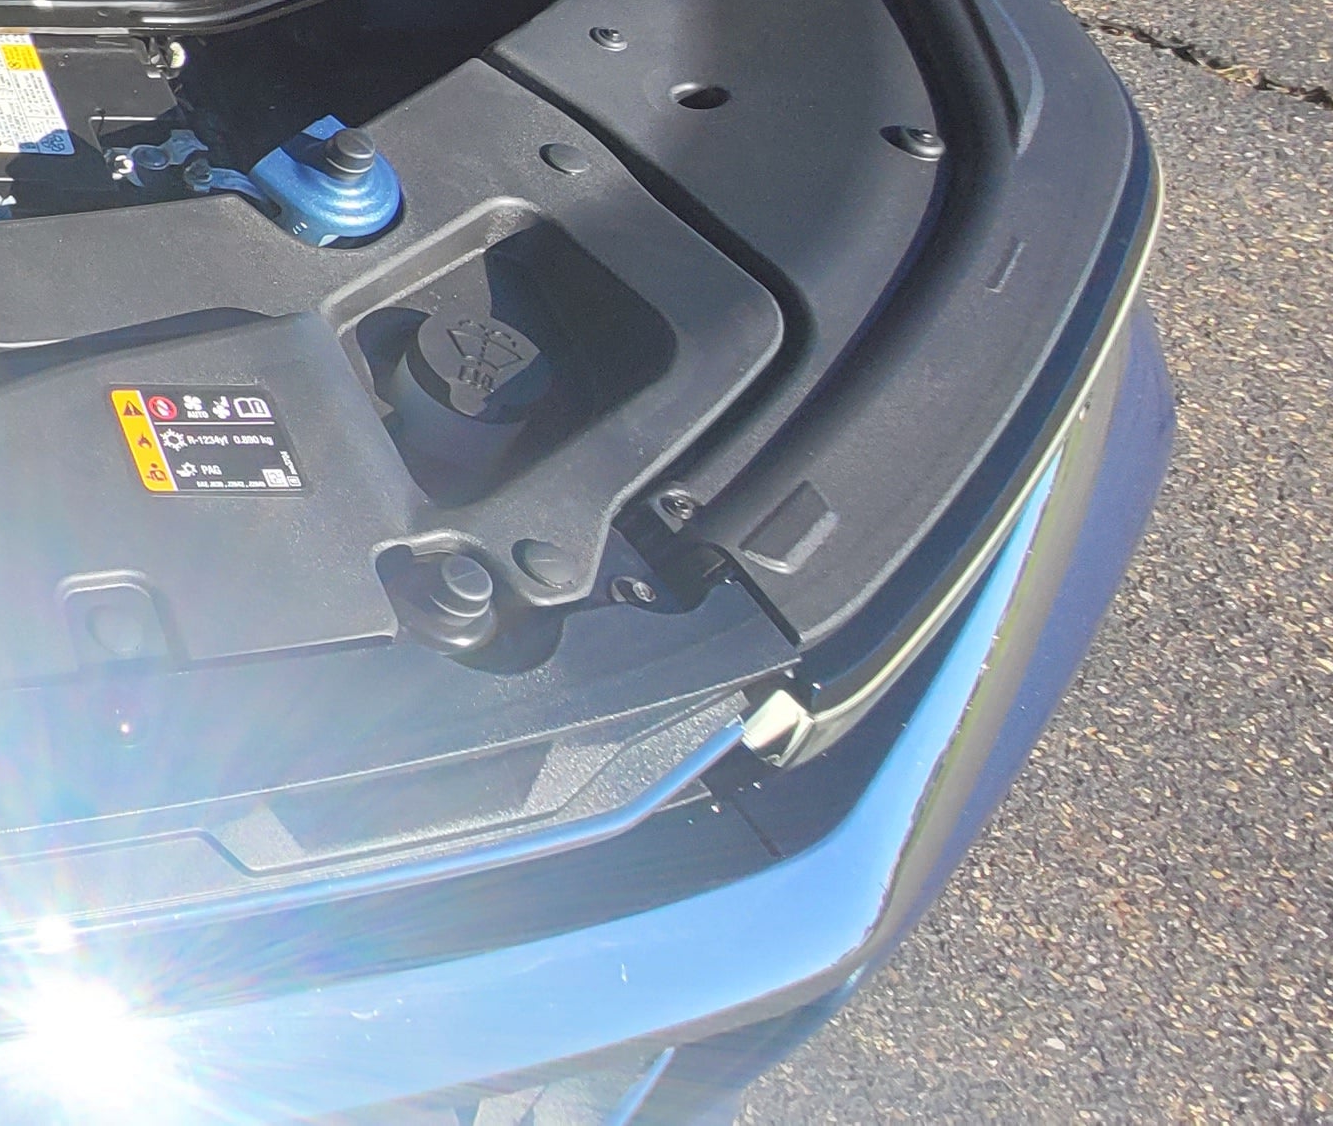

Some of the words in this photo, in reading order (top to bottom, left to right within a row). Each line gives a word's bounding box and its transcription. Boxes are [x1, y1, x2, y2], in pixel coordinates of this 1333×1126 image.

[186, 410, 209, 419] AUTO
[259, 435, 274, 446] kg
[200, 464, 223, 476] PAG
